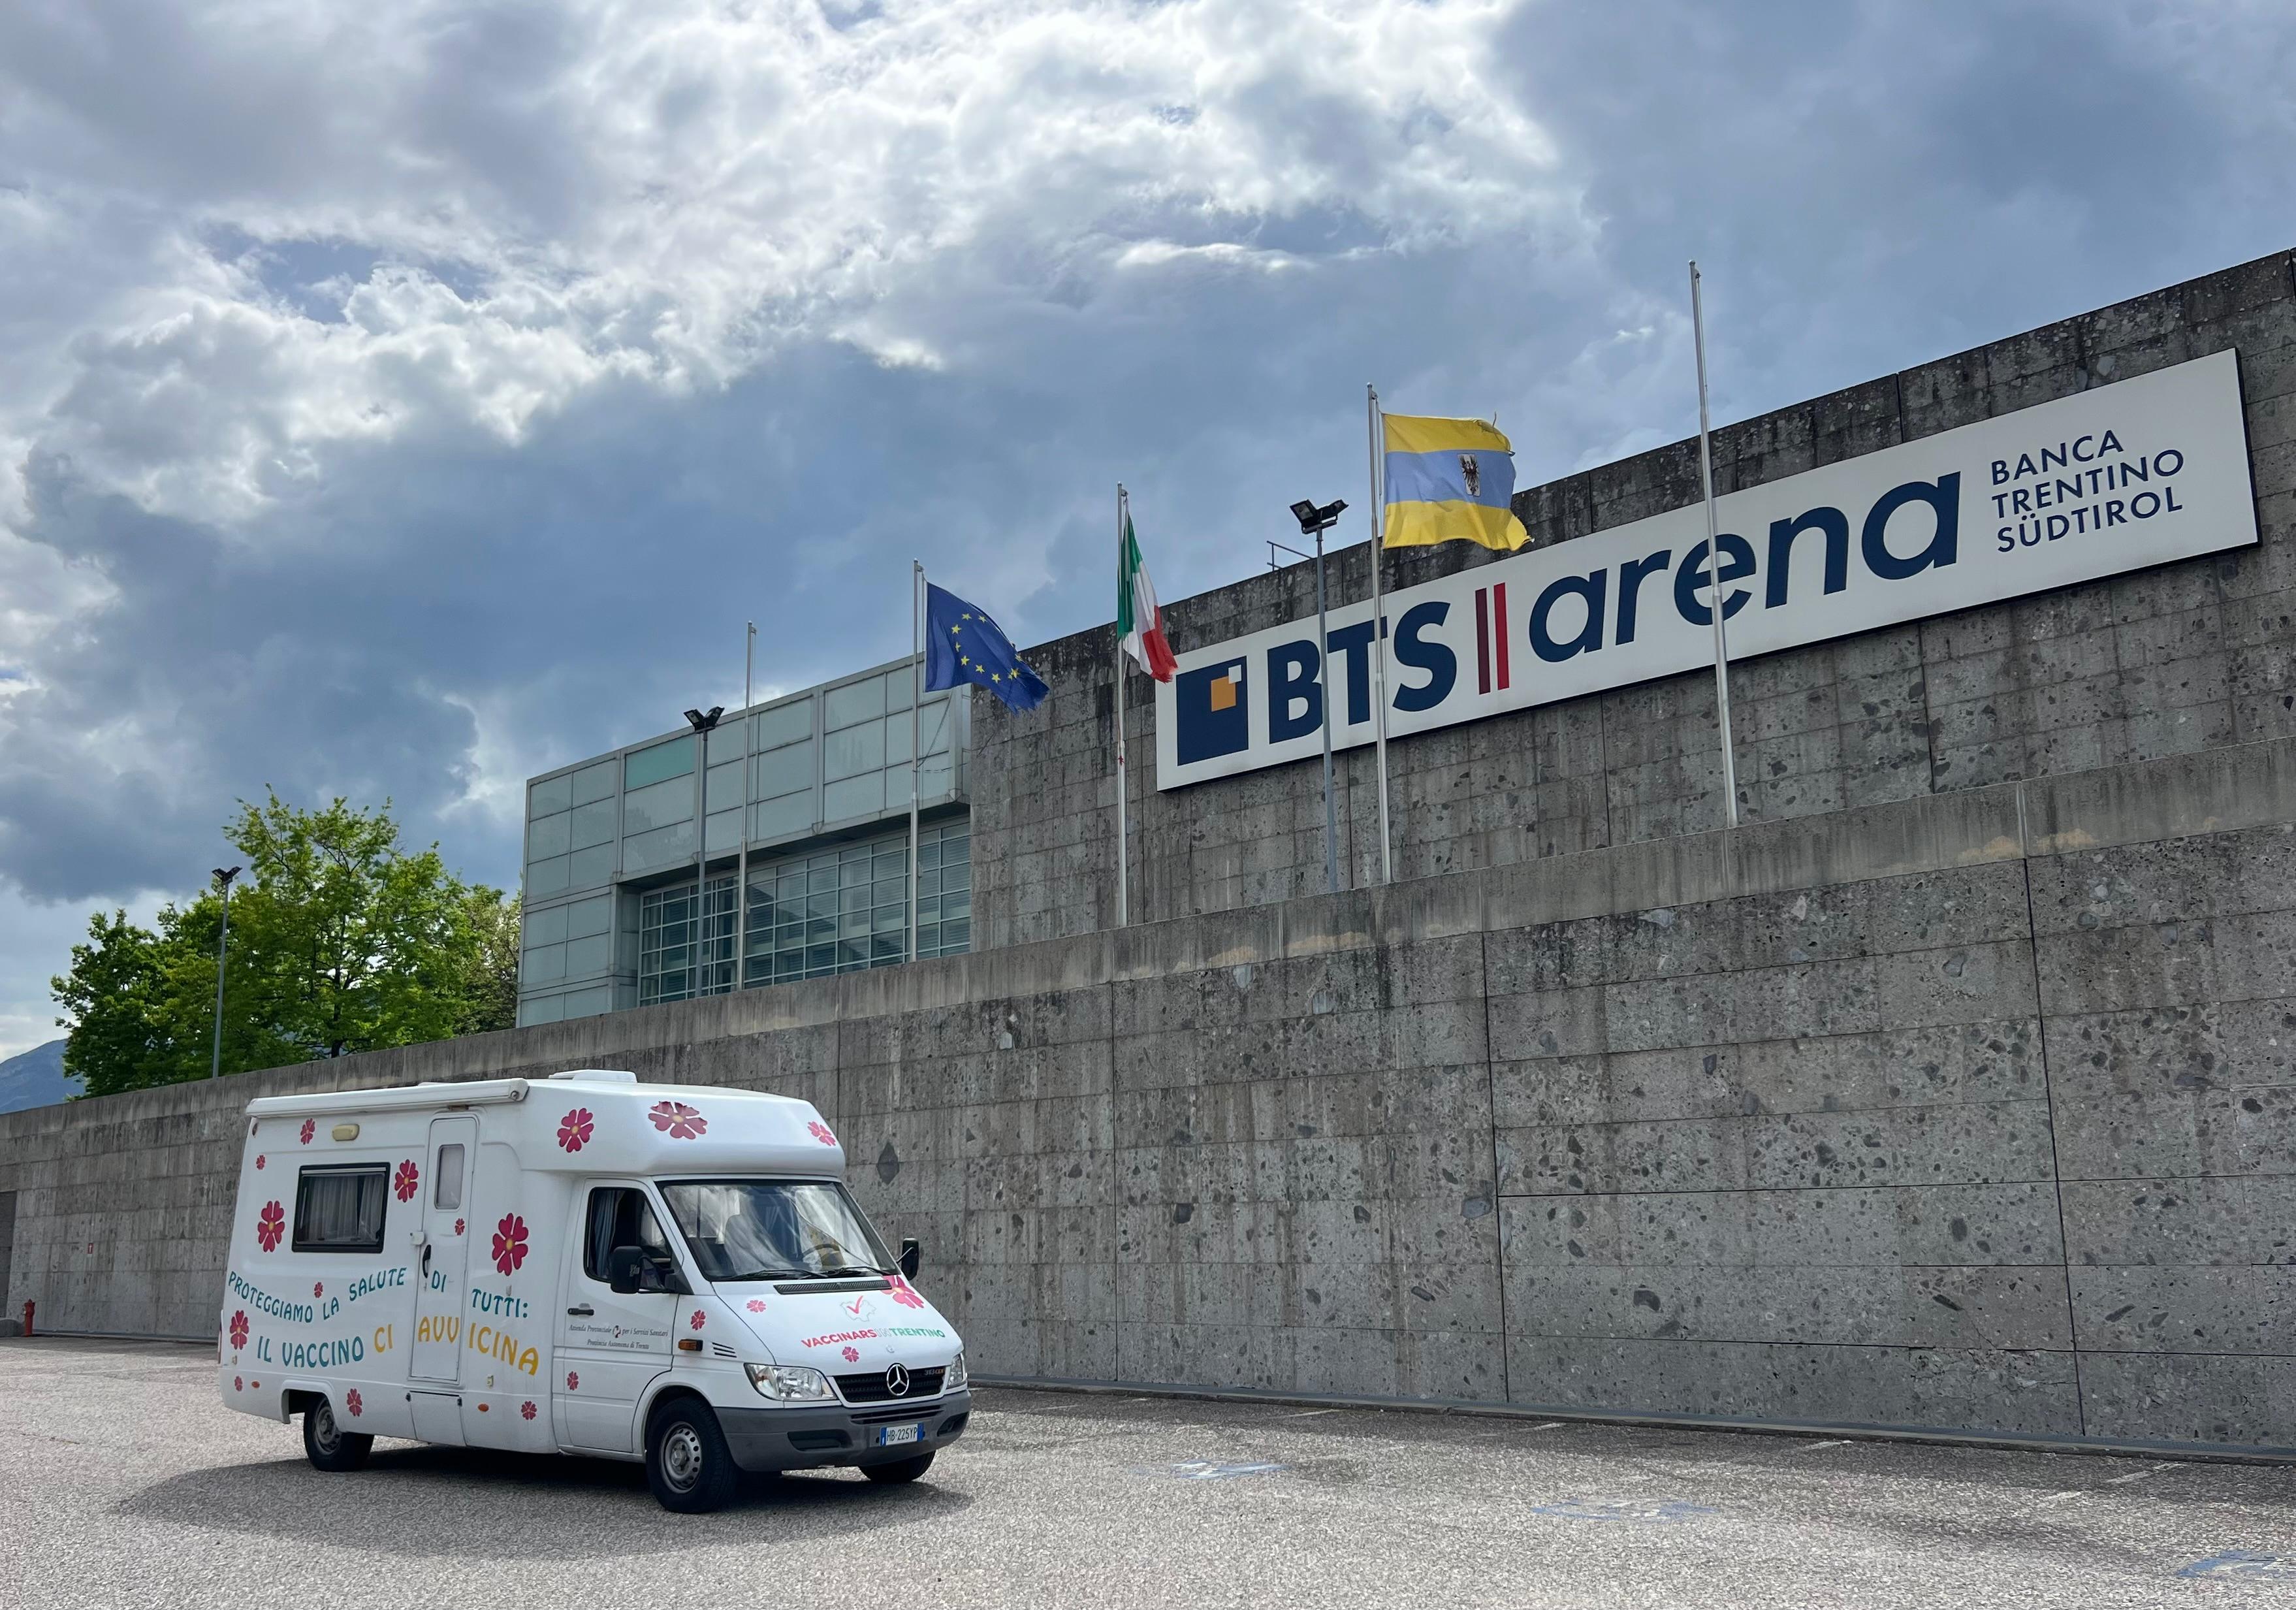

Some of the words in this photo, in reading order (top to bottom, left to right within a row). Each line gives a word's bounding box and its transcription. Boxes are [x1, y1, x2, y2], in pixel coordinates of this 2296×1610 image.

[1991, 430, 2124, 486] BANCA
[1992, 449, 2184, 519] TRENTINO
[1997, 487, 2183, 553] SÜDTIROL
[1268, 601, 1457, 745] BTS
[1529, 471, 1961, 664] arena
[229, 1270, 313, 1323] PROTEGGIAMO
[323, 1296, 340, 1320] LA
[349, 1267, 407, 1302] SALUTE
[431, 1270, 447, 1293] DI
[472, 1289, 528, 1318] TUTTI:
[257, 1336, 272, 1363] IL
[282, 1336, 364, 1368] VACCINO
[374, 1324, 393, 1353] CI
